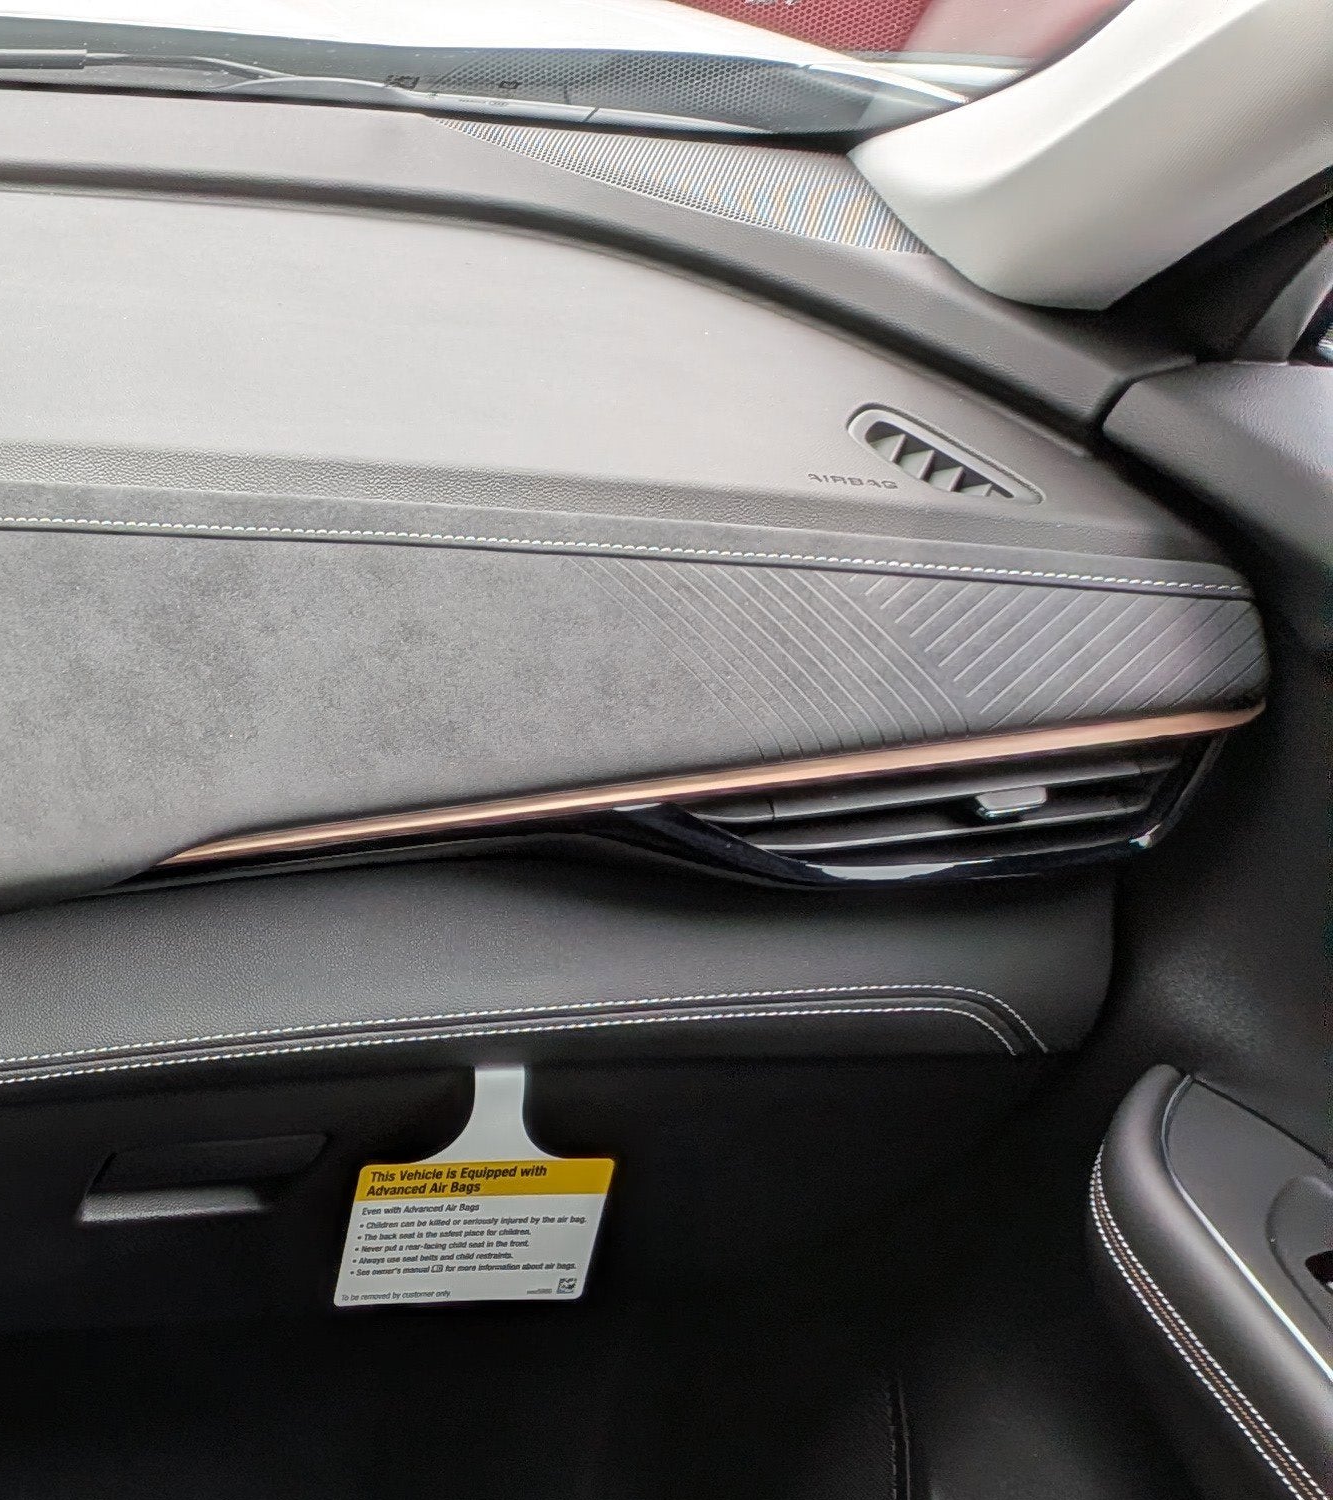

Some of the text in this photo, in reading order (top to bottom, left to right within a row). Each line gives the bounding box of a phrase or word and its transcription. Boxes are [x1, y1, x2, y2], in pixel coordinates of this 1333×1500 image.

[808, 473, 899, 490] AIRBAG
[371, 1171, 395, 1182] This
[400, 1169, 442, 1180] Vehicle
[460, 1166, 517, 1180] Equipped
[520, 1165, 547, 1177] with
[367, 1182, 480, 1196] Advanced Air Bags
[362, 1203, 479, 1215] Even with Advanced Air Bags
[366, 1220, 398, 1229] Children
[429, 1218, 450, 1226] killed
[463, 1217, 498, 1227] seriously
[501, 1216, 528, 1225] injured
[557, 1215, 568, 1223] air
[570, 1215, 586, 1224] bag.
